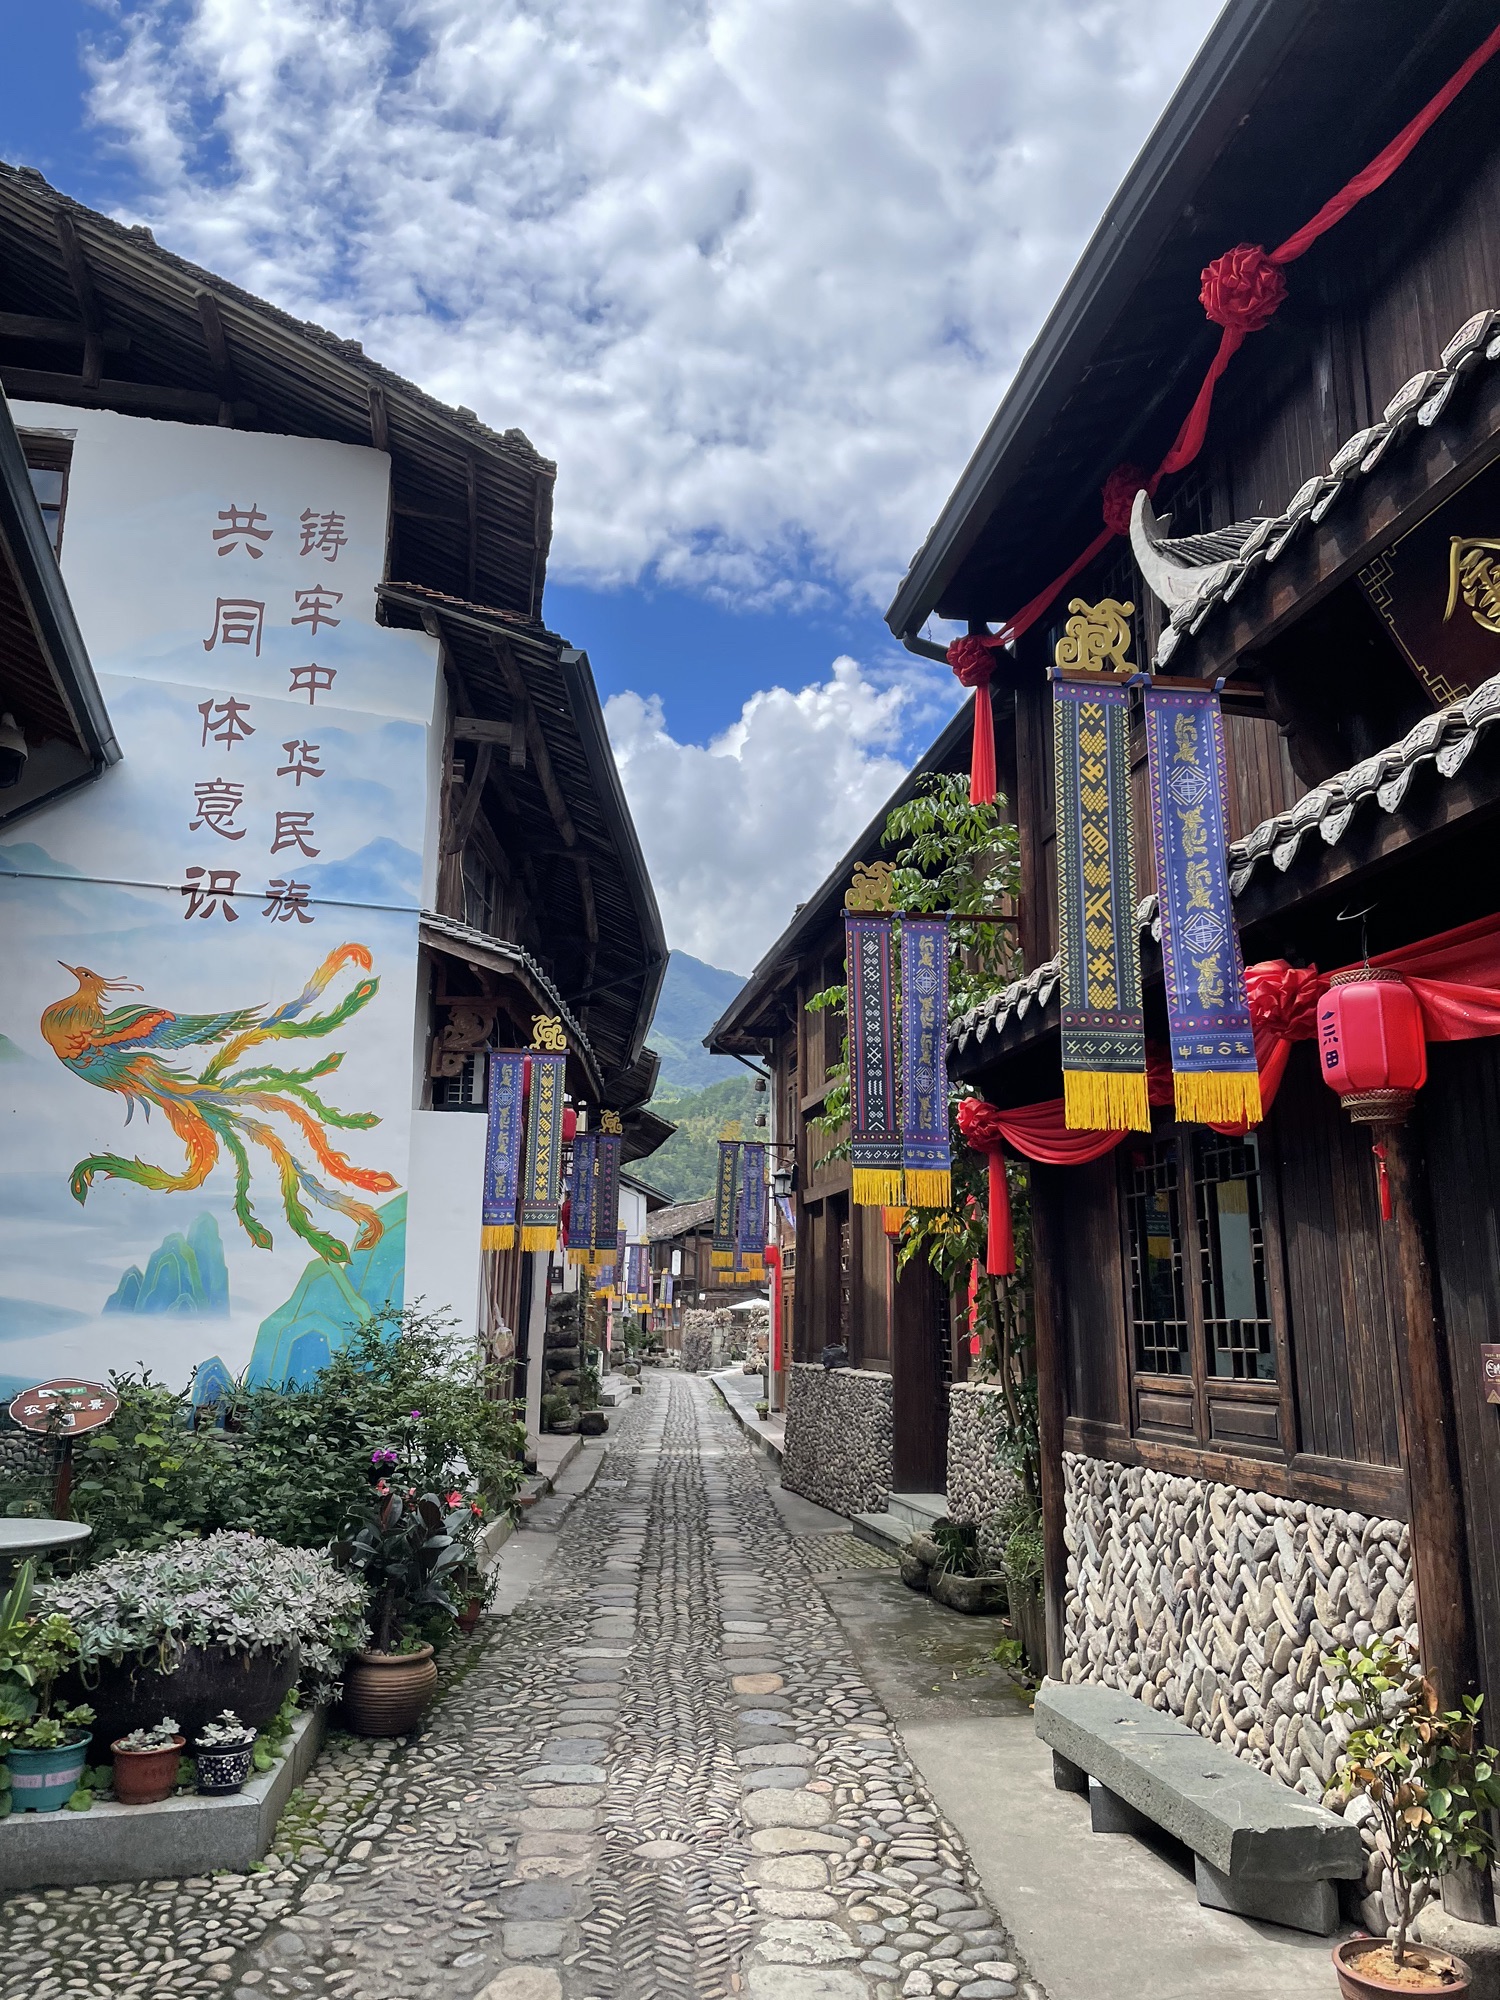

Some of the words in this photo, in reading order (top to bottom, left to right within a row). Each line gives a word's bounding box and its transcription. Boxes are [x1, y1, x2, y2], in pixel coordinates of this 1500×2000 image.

[180, 502, 274, 922] 共同体意识
[261, 507, 349, 924] 铸牢中华民族
